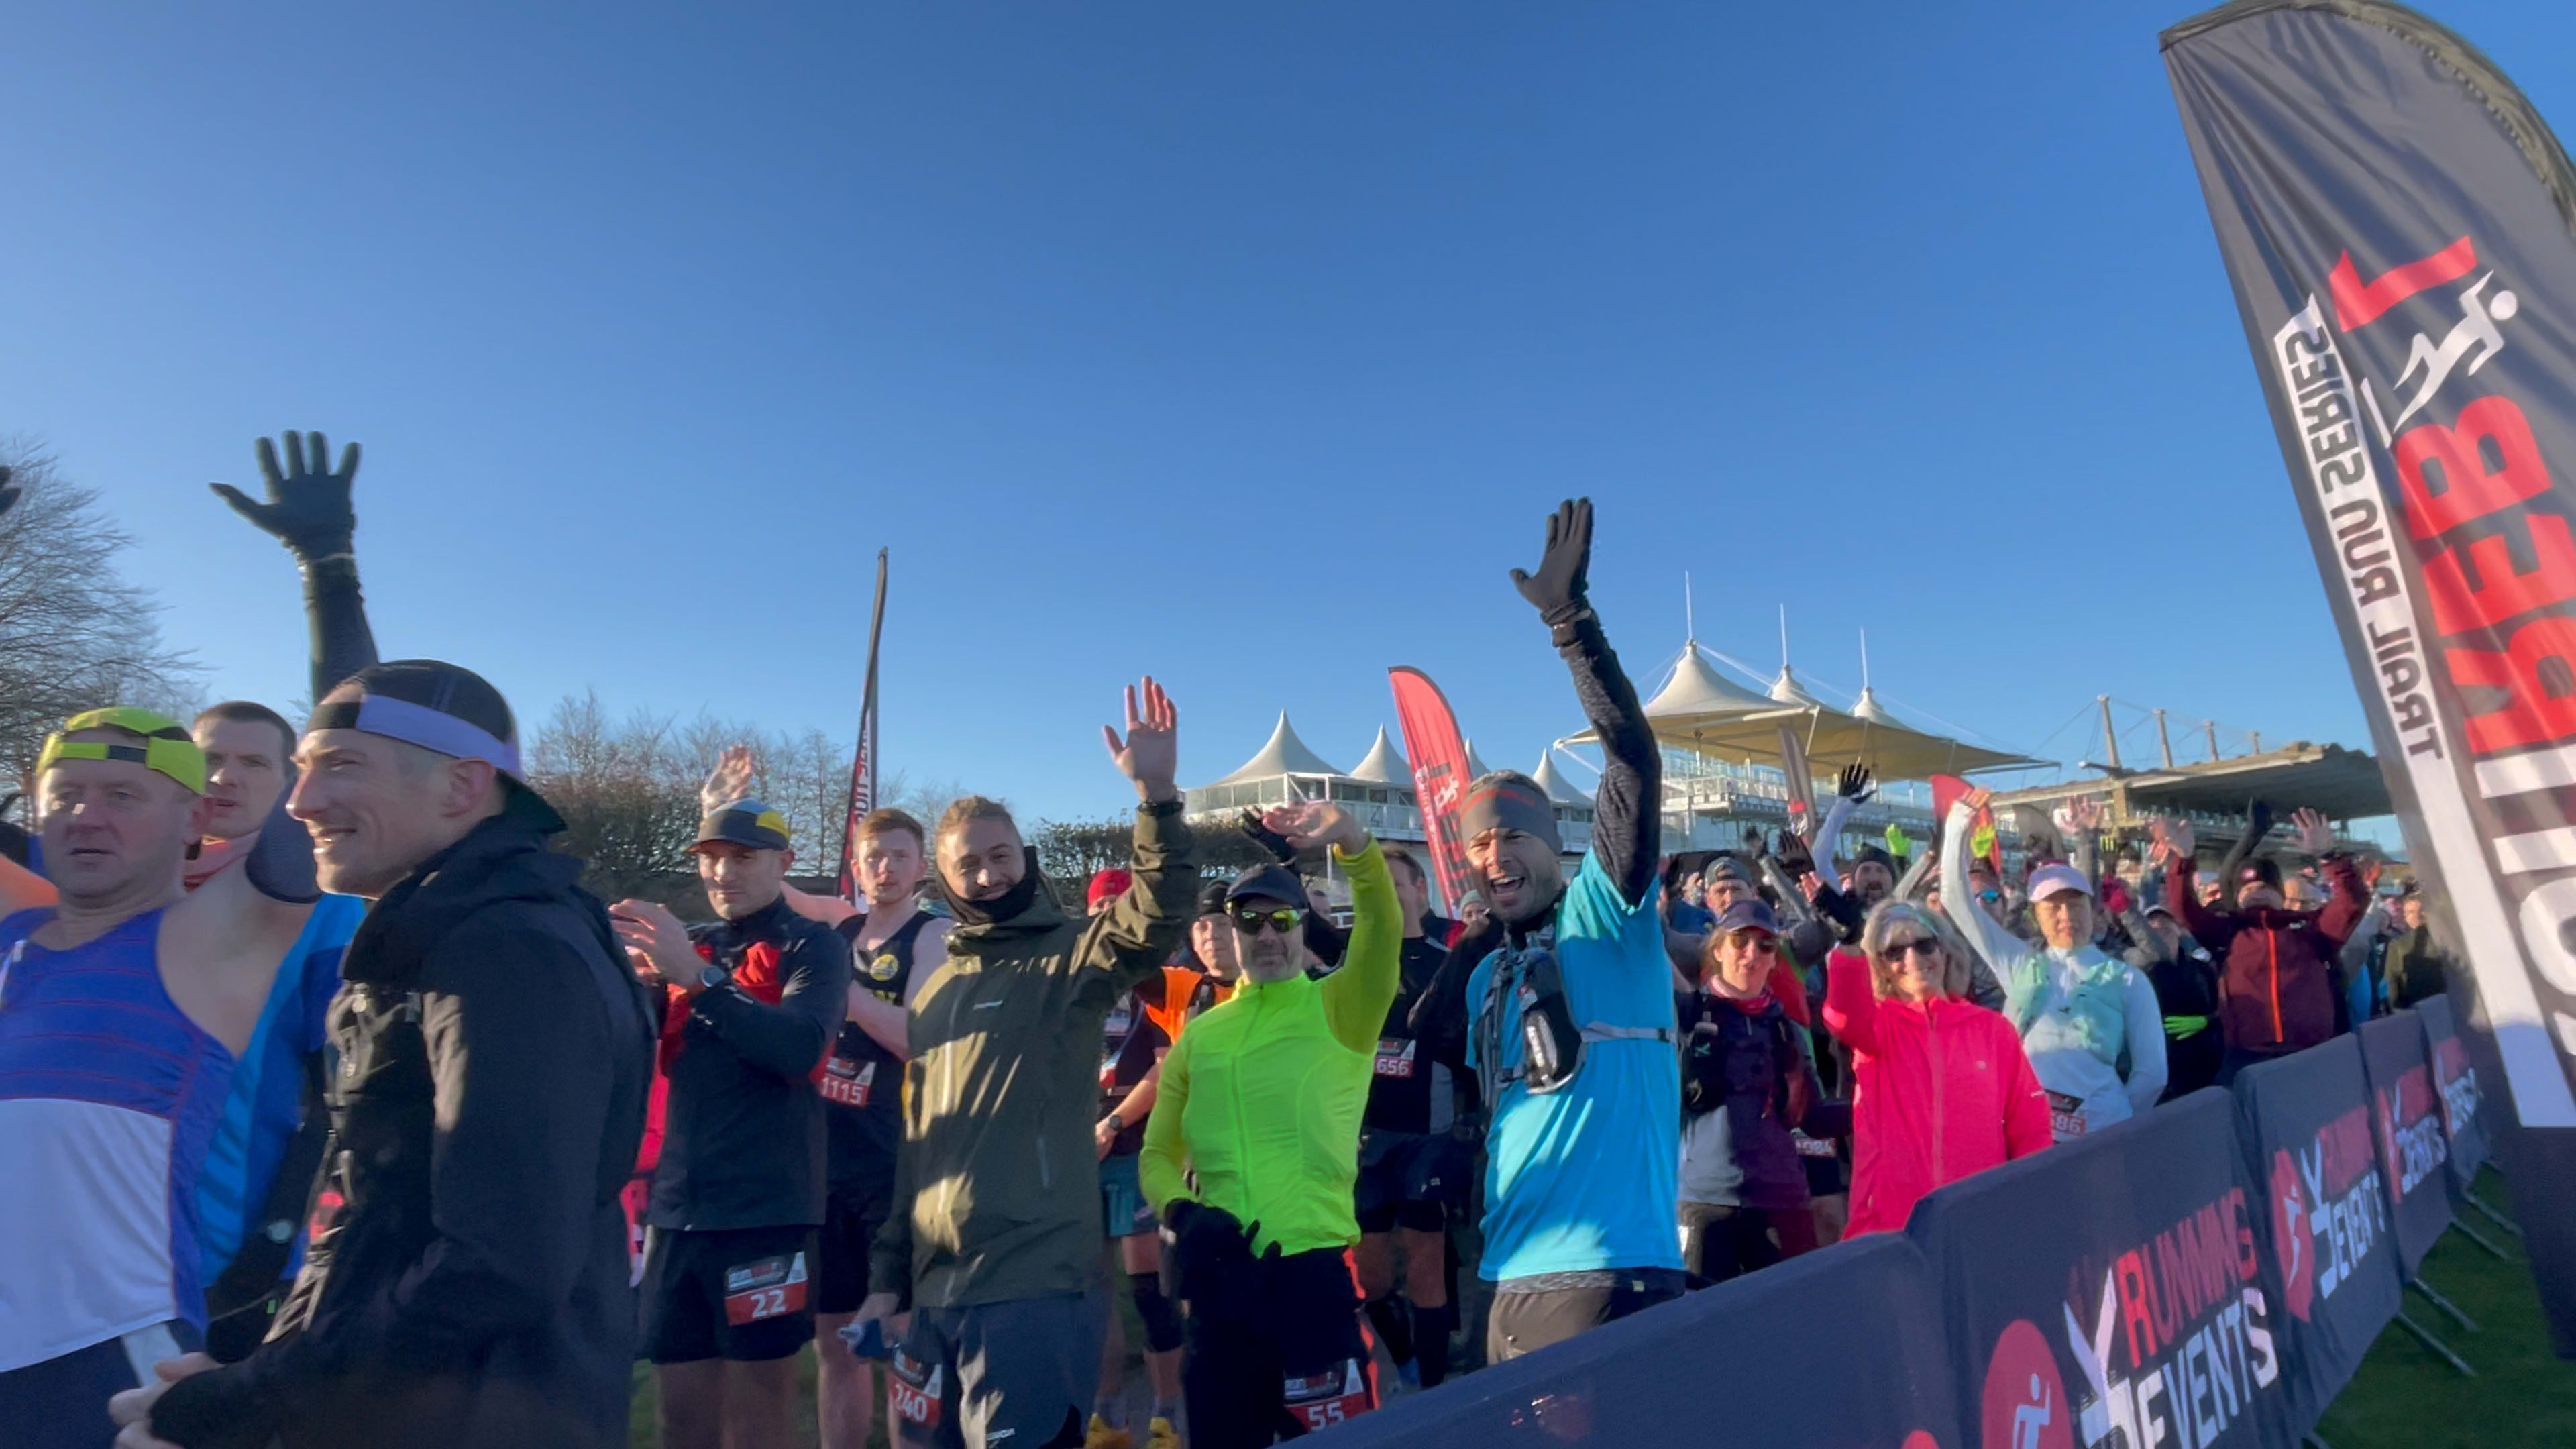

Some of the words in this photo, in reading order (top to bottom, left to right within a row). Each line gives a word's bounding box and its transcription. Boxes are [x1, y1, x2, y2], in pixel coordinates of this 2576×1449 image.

[1376, 1059, 1409, 1076] 656
[821, 1076, 864, 1105] 1115
[2051, 1114, 2082, 1135] 86
[751, 1289, 787, 1318] 22
[1308, 1401, 1346, 1431] 55
